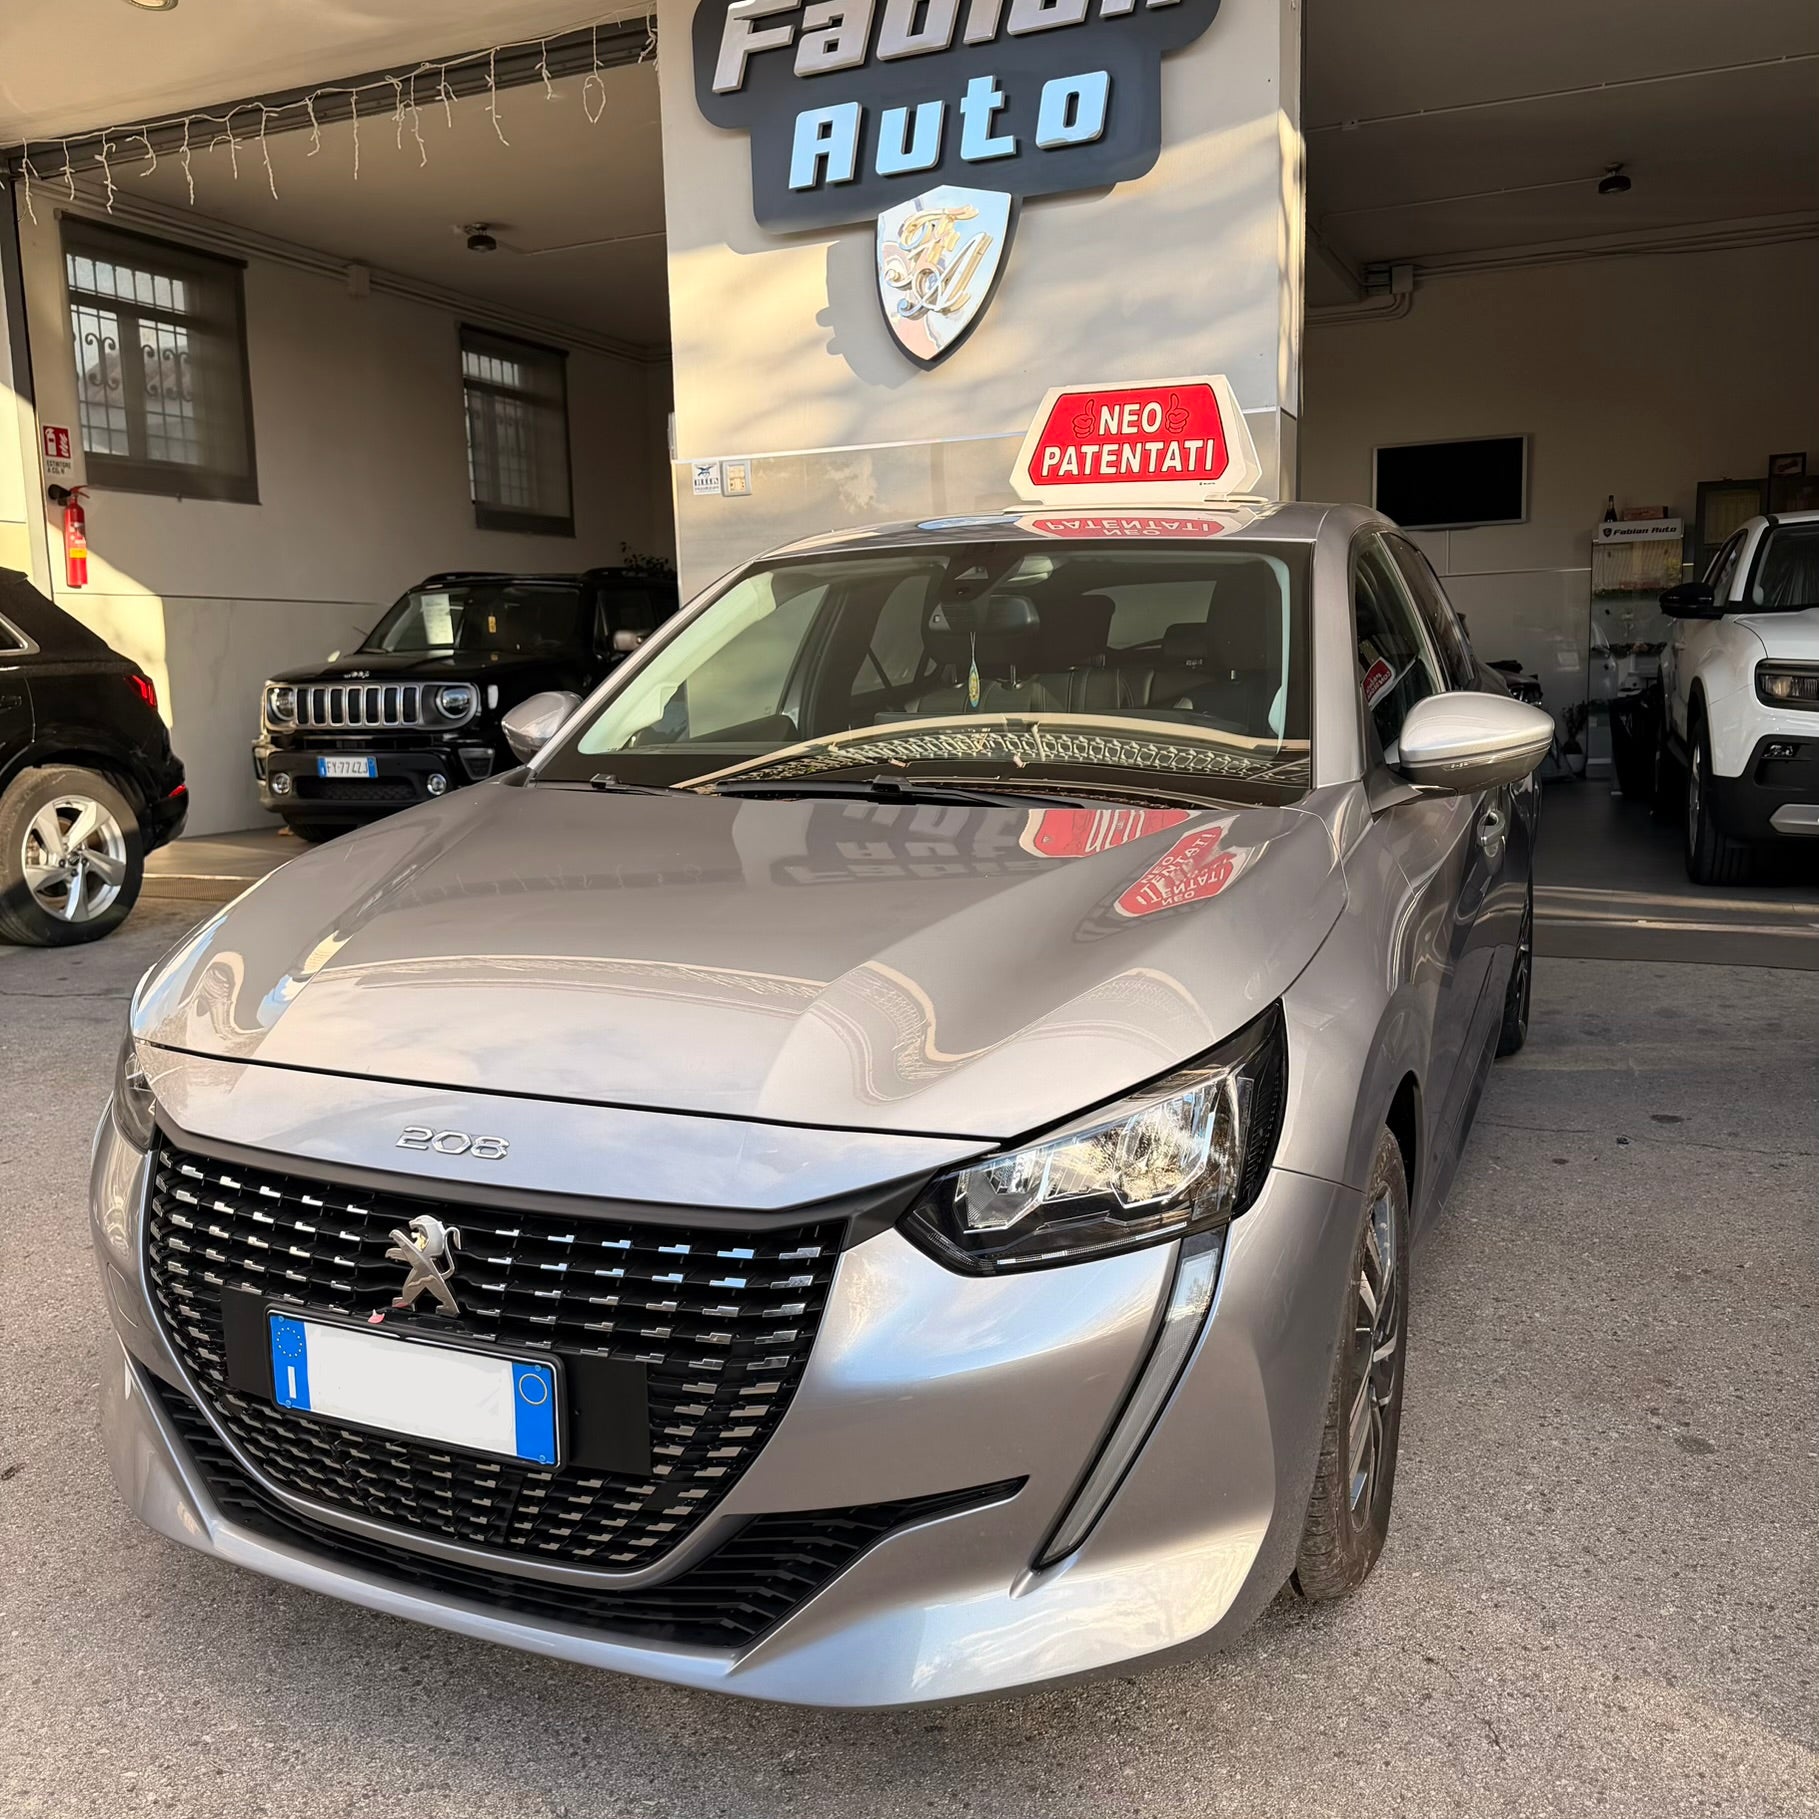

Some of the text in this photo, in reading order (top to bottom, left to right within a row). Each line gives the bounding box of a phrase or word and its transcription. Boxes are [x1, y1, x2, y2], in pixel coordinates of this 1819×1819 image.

[788, 70, 1111, 190] Auto
[1098, 401, 1163, 436] NEO
[1040, 438, 1215, 478] PATENTATI
[1613, 526, 1677, 536] Fabian Auto
[395, 1125, 510, 1160] 208
